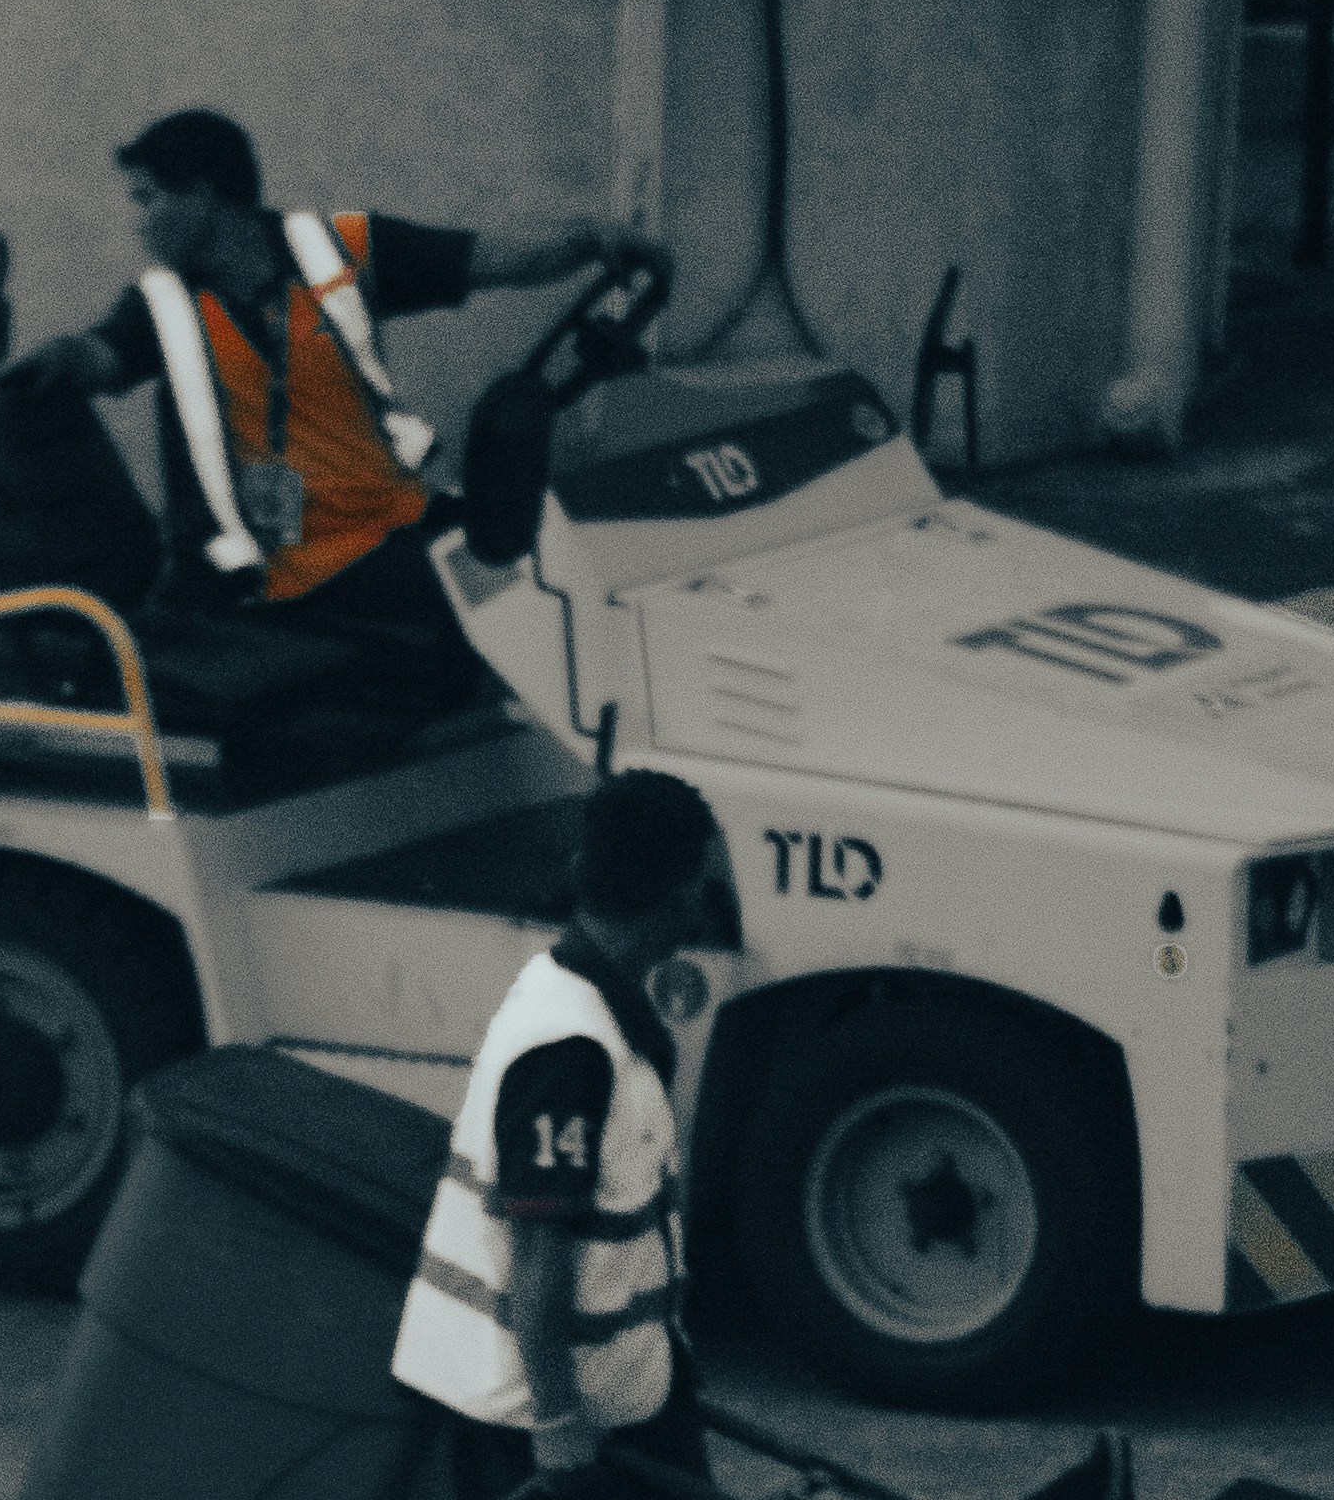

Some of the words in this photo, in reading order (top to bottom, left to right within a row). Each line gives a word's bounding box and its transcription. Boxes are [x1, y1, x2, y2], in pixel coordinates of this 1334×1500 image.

[683, 444, 759, 501] TLD
[949, 603, 1224, 685] TLD
[763, 829, 883, 900] TLD
[533, 1112, 588, 1169] 14
